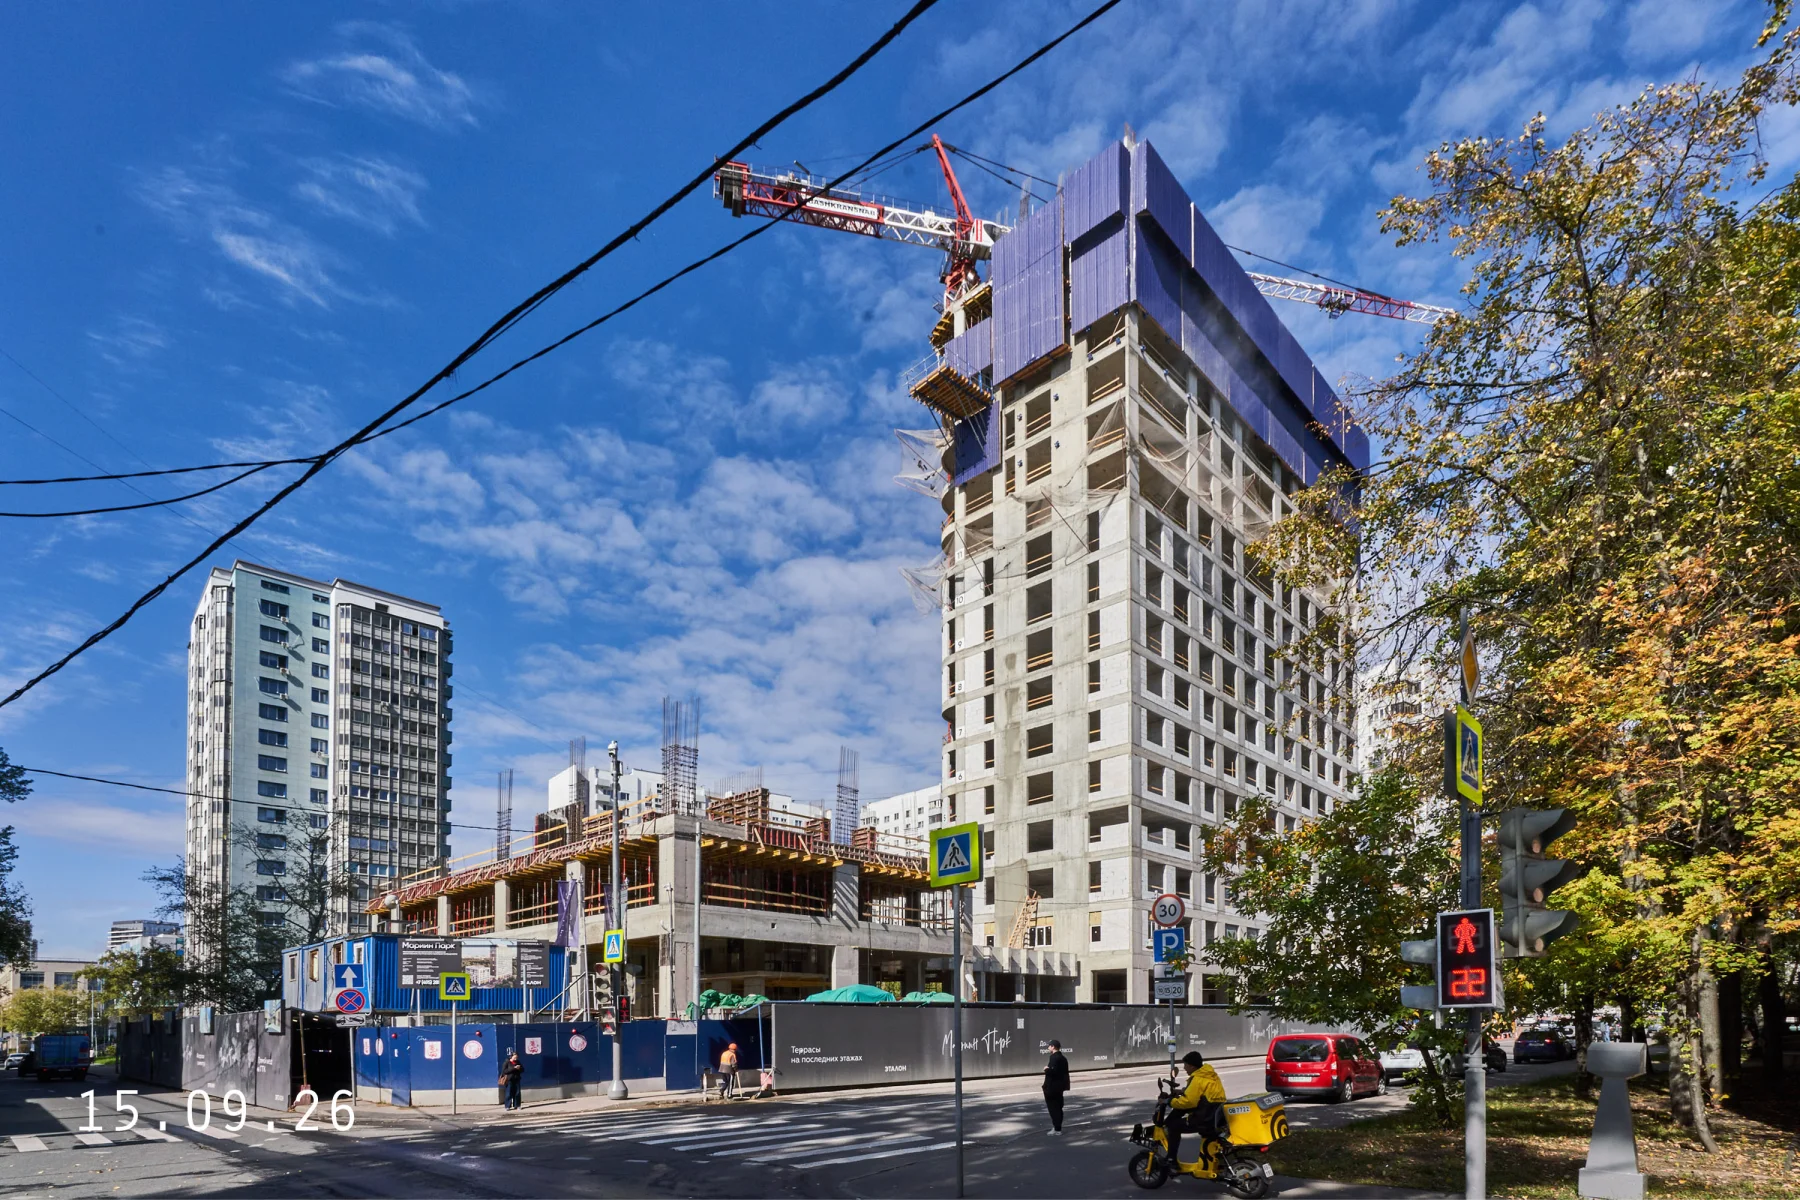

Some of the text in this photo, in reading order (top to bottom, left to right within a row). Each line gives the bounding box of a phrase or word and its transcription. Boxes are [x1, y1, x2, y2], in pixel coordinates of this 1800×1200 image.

[1159, 903, 1177, 918] 30
[402, 942, 455, 950] Мариин Парк
[1162, 932, 1179, 958] P
[1451, 968, 1486, 997] 22
[1172, 986, 1182, 994] 20
[981, 1027, 1012, 1055] Парк
[791, 1046, 821, 1055] Террасы
[802, 1056, 839, 1064] последних
